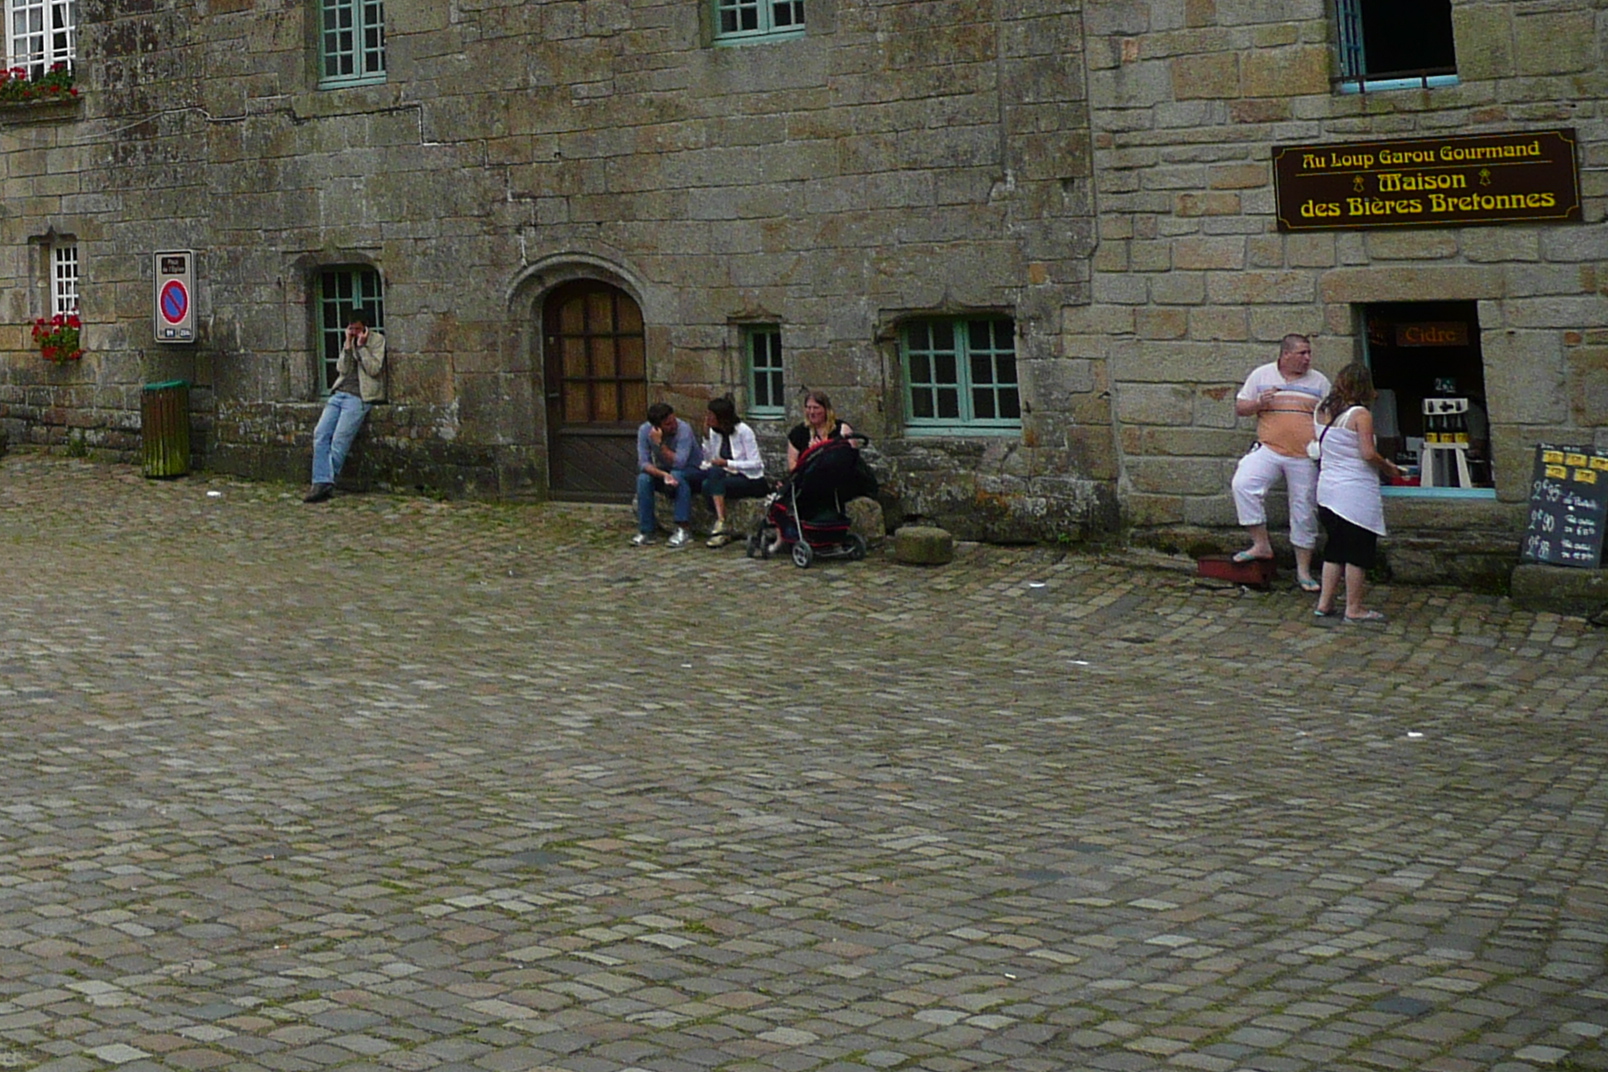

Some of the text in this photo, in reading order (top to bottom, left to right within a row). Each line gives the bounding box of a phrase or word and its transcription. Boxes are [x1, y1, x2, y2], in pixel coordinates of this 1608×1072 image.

[1303, 140, 1541, 169] Au Loup Garou Gourmand
[1377, 172, 1467, 192] Maison
[1300, 192, 1556, 217] des Bières Bretonnes
[1405, 327, 1457, 343] Cidre
